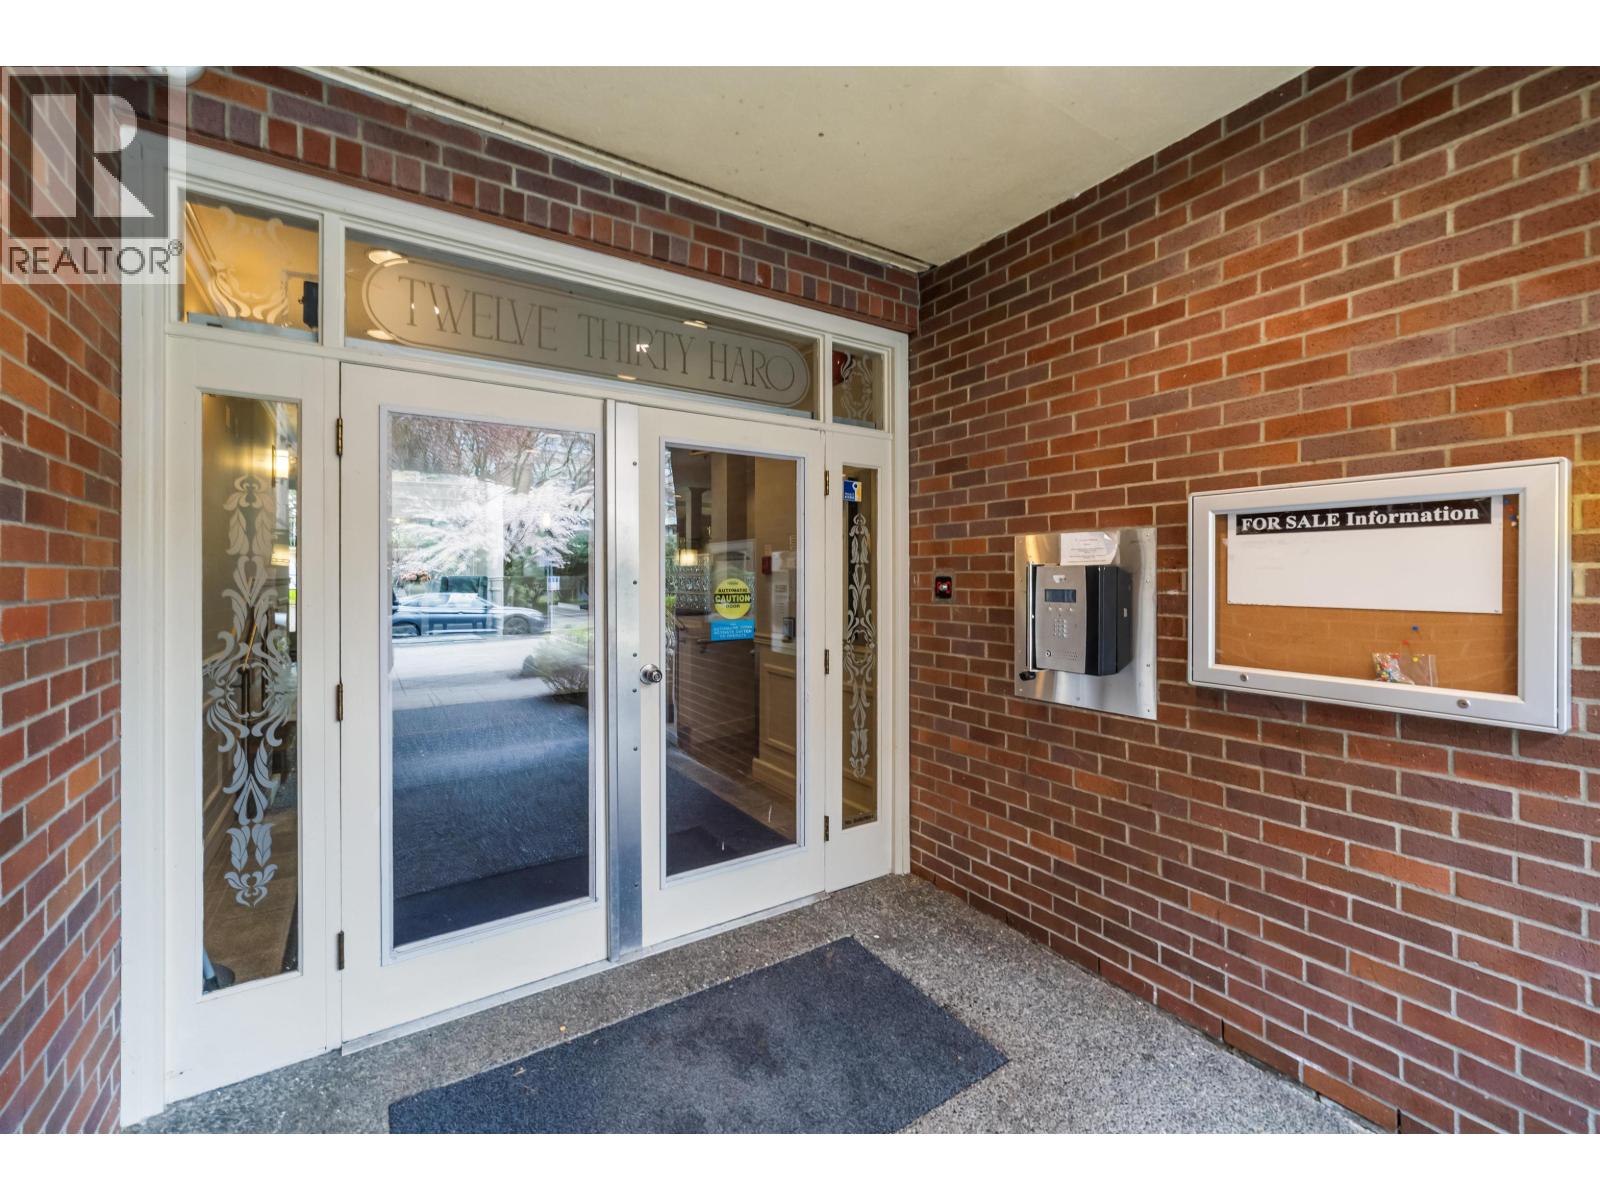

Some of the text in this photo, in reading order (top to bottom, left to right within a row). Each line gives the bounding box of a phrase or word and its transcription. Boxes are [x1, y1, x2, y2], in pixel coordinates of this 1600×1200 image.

[398, 276, 795, 392] TWELVE THIRTY HARO
[1240, 505, 1480, 531] FOR SALE Information
[714, 594, 751, 603] CAUTION
